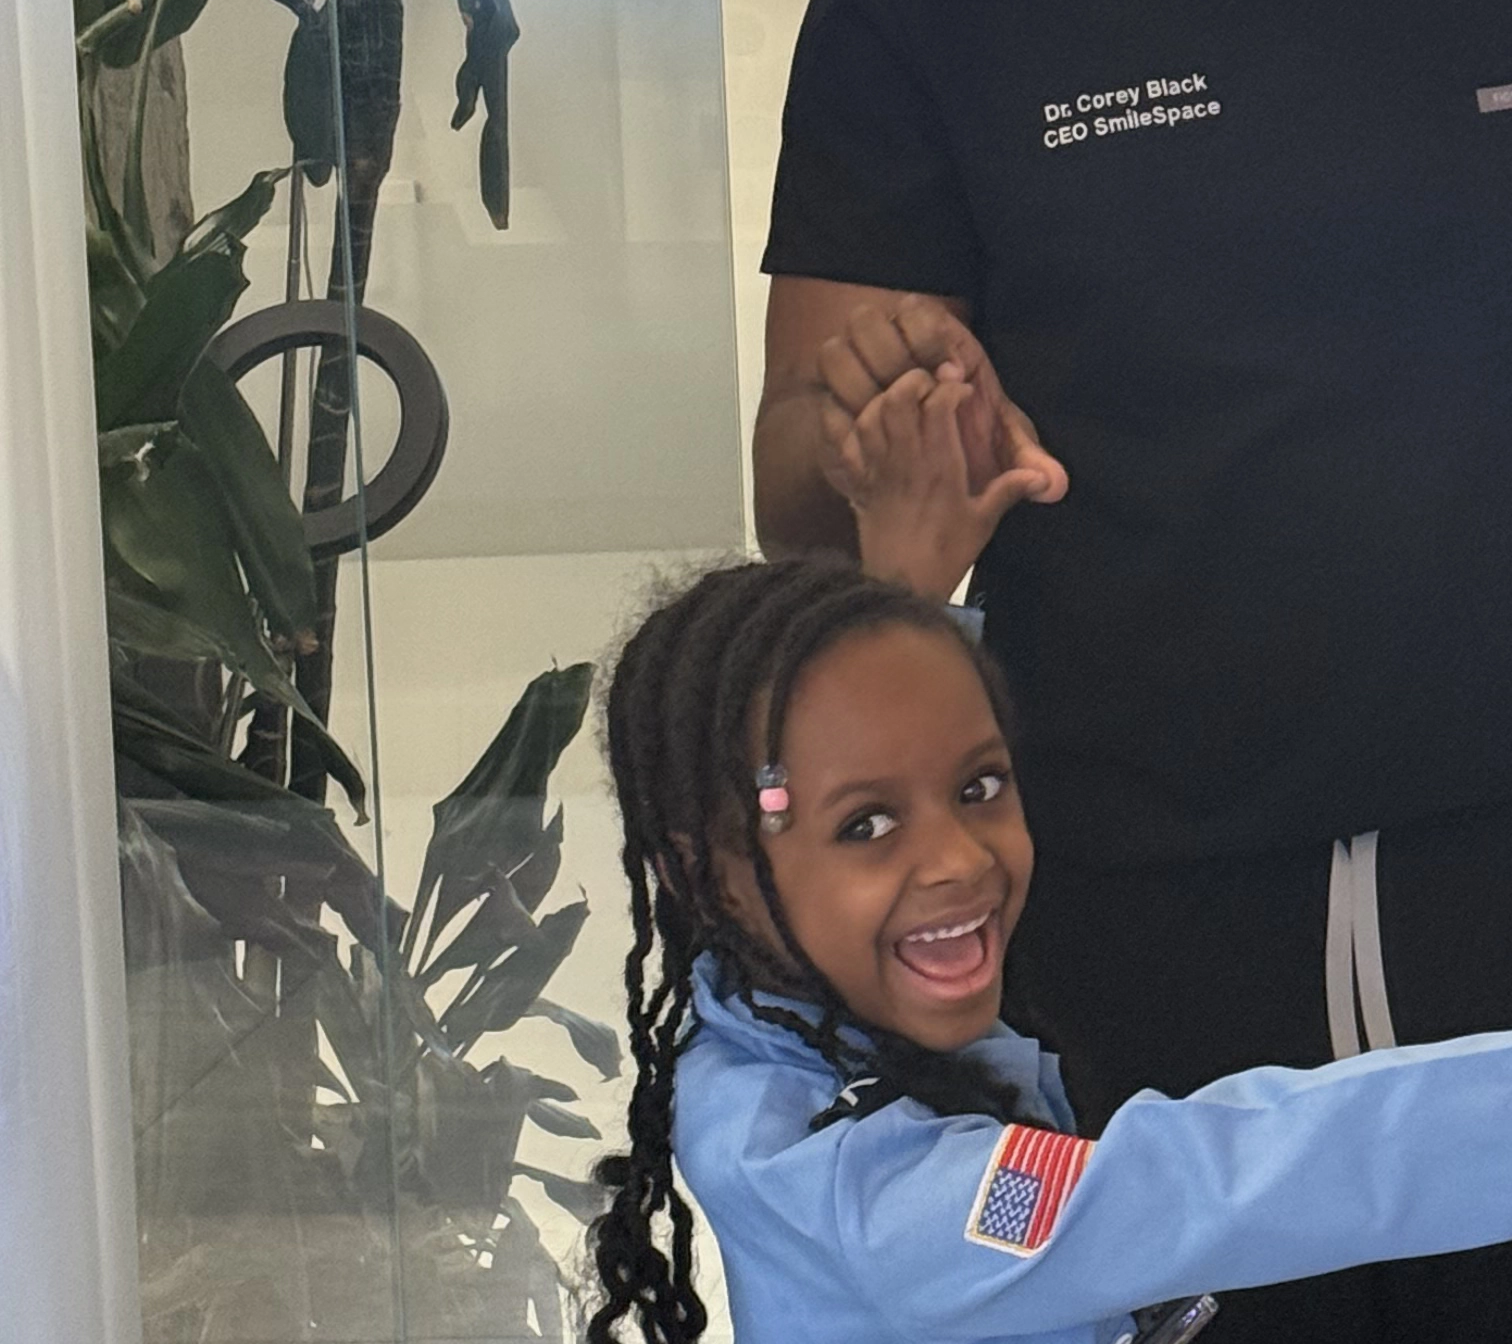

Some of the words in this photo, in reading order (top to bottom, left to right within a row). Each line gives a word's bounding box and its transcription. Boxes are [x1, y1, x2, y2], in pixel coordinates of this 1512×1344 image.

[1076, 86, 1140, 113] Corey
[1146, 73, 1208, 99] Black
[1043, 122, 1088, 149] CEO
[1093, 100, 1222, 136] SmileSpace
